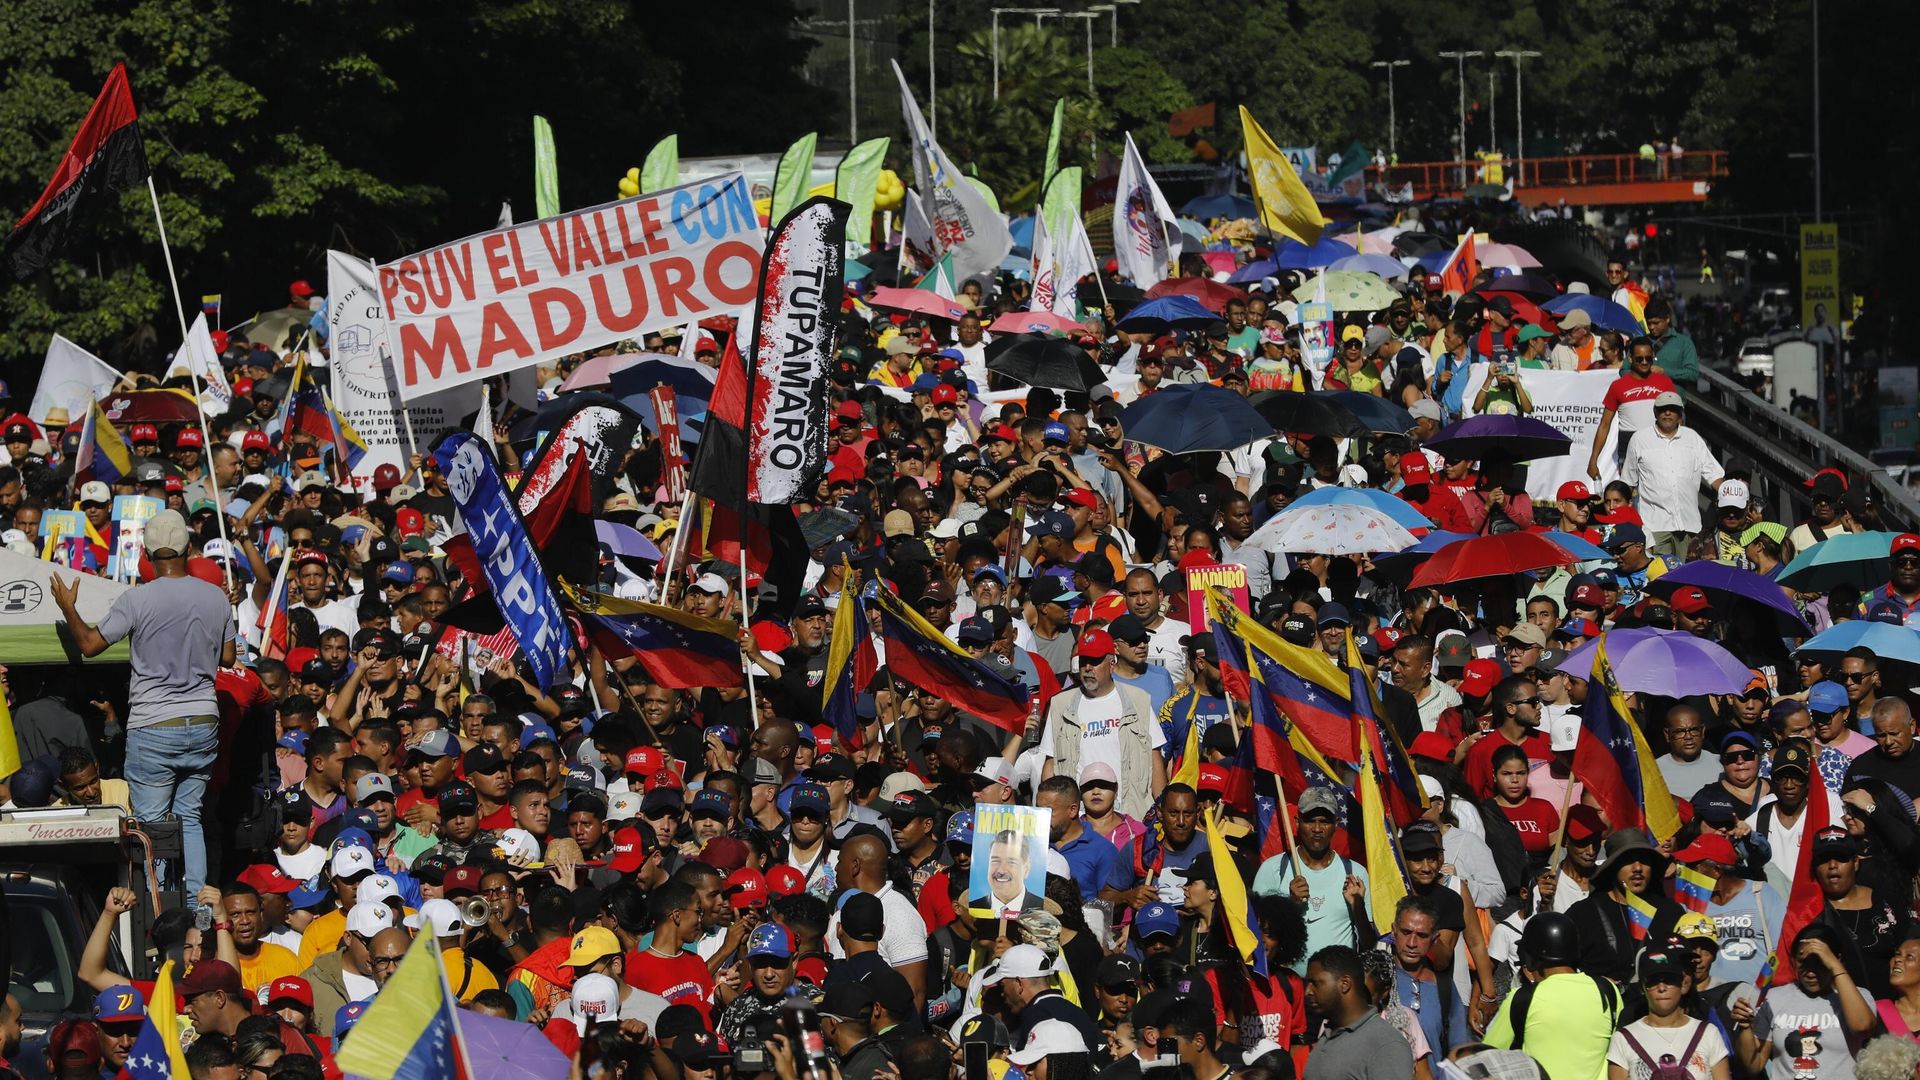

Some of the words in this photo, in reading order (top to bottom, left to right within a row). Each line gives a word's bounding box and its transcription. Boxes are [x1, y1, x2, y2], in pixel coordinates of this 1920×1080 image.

[379, 242, 476, 321] PSUV
[482, 230, 539, 294] EL
[539, 198, 671, 277] VALLE
[670, 176, 757, 244] CON
[344, 287, 359, 303] DE
[366, 307, 383, 319] CL
[400, 241, 763, 386] MADURO
[769, 264, 825, 471] TUPAMARO
[346, 381, 397, 400] DISTRITO
[368, 407, 444, 417] Transprtistas
[396, 426, 446, 436] Prsident
[376, 437, 420, 446] MADUO
[1722, 486, 1744, 497] SALUD
[1190, 571, 1246, 591] MADURO
[488, 530, 557, 652] PPT
[1080, 717, 1121, 734] omuna
[27, 823, 114, 840] Imcarven
[1241, 1013, 1281, 1026] MADURO
[1241, 1024, 1280, 1039] SOMOS
